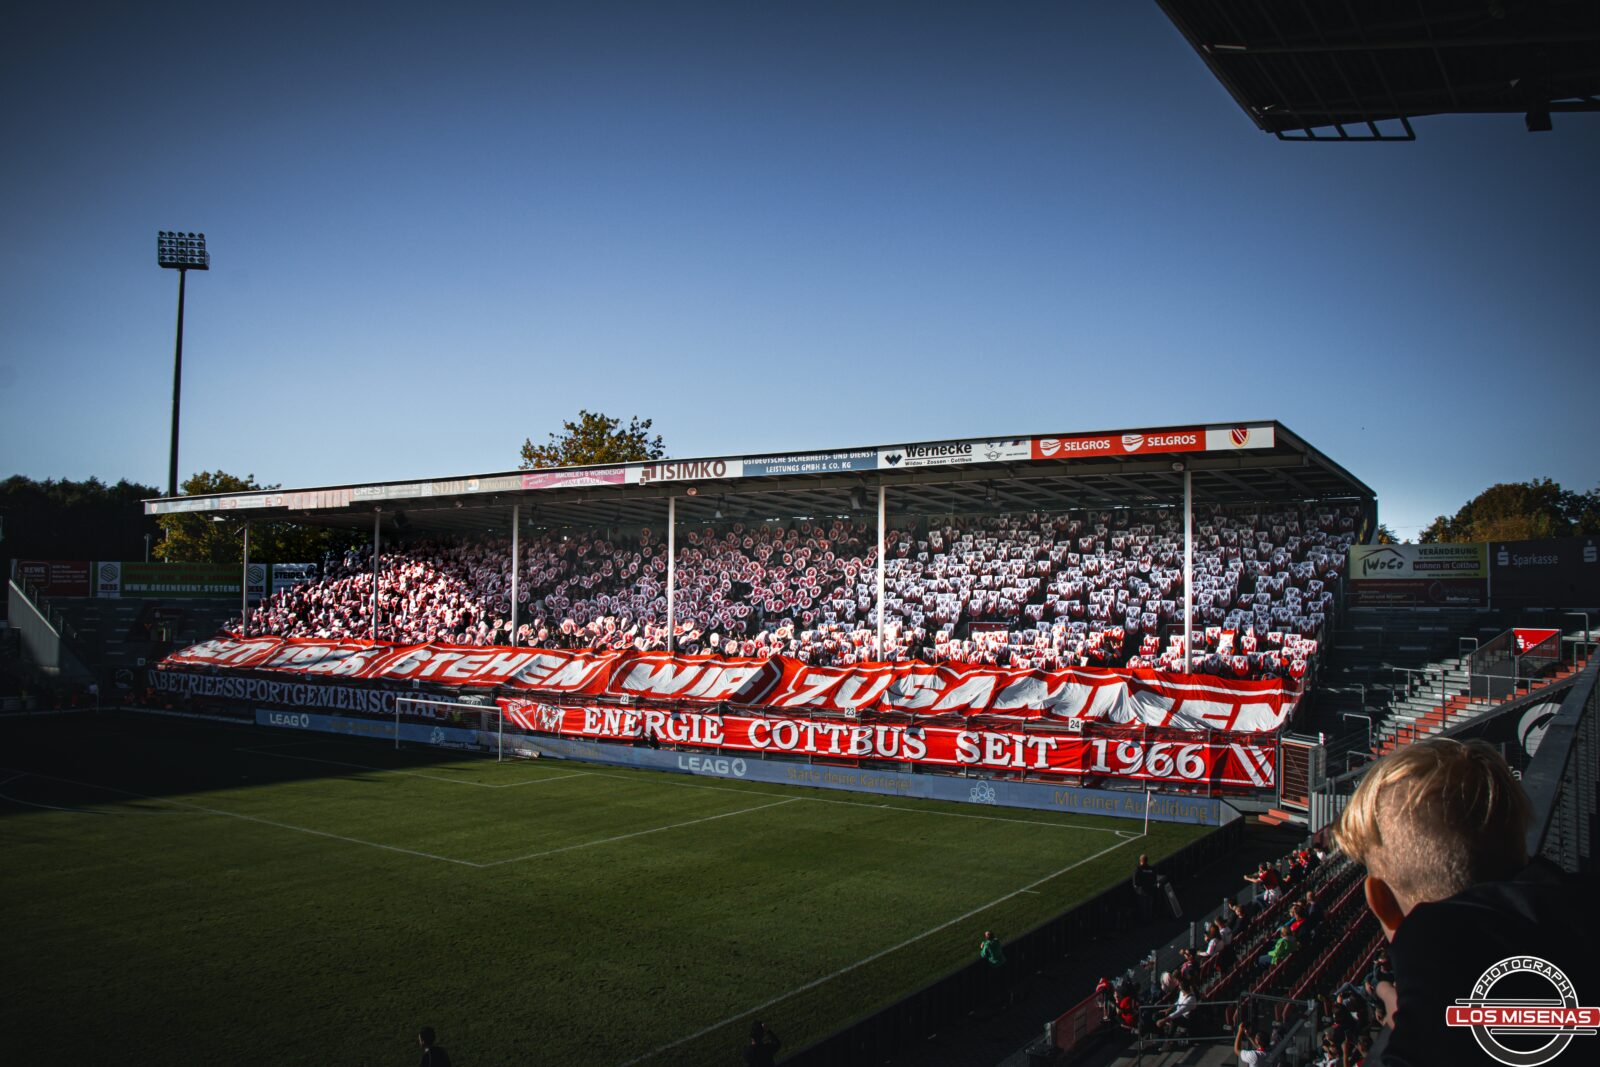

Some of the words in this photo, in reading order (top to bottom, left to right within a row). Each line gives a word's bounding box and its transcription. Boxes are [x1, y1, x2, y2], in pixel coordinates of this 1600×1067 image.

[1064, 439, 1111, 451] SELGROS
[1147, 434, 1197, 447] SELGROS
[905, 441, 972, 458] Wernecke
[660, 459, 727, 480] ISIMKO
[766, 463, 800, 473] LEISTUNGS
[841, 461, 852, 469] KG
[1512, 553, 1559, 568] Sparkasse
[178, 638, 274, 662] SEIT
[268, 645, 379, 677] 1966
[391, 648, 607, 688] STEHEN
[620, 661, 765, 699] WIR
[269, 711, 299, 728] LEAG
[845, 707, 855, 717] 23
[1069, 719, 1081, 730] 24
[582, 705, 725, 746] ENERGIE
[747, 718, 928, 761] COTTBUS
[955, 730, 1058, 769] SEIT
[1091, 738, 1206, 780] 1966
[678, 754, 729, 775] LEAG
[1055, 790, 1079, 807] Mit
[1082, 795, 1120, 812] einer
